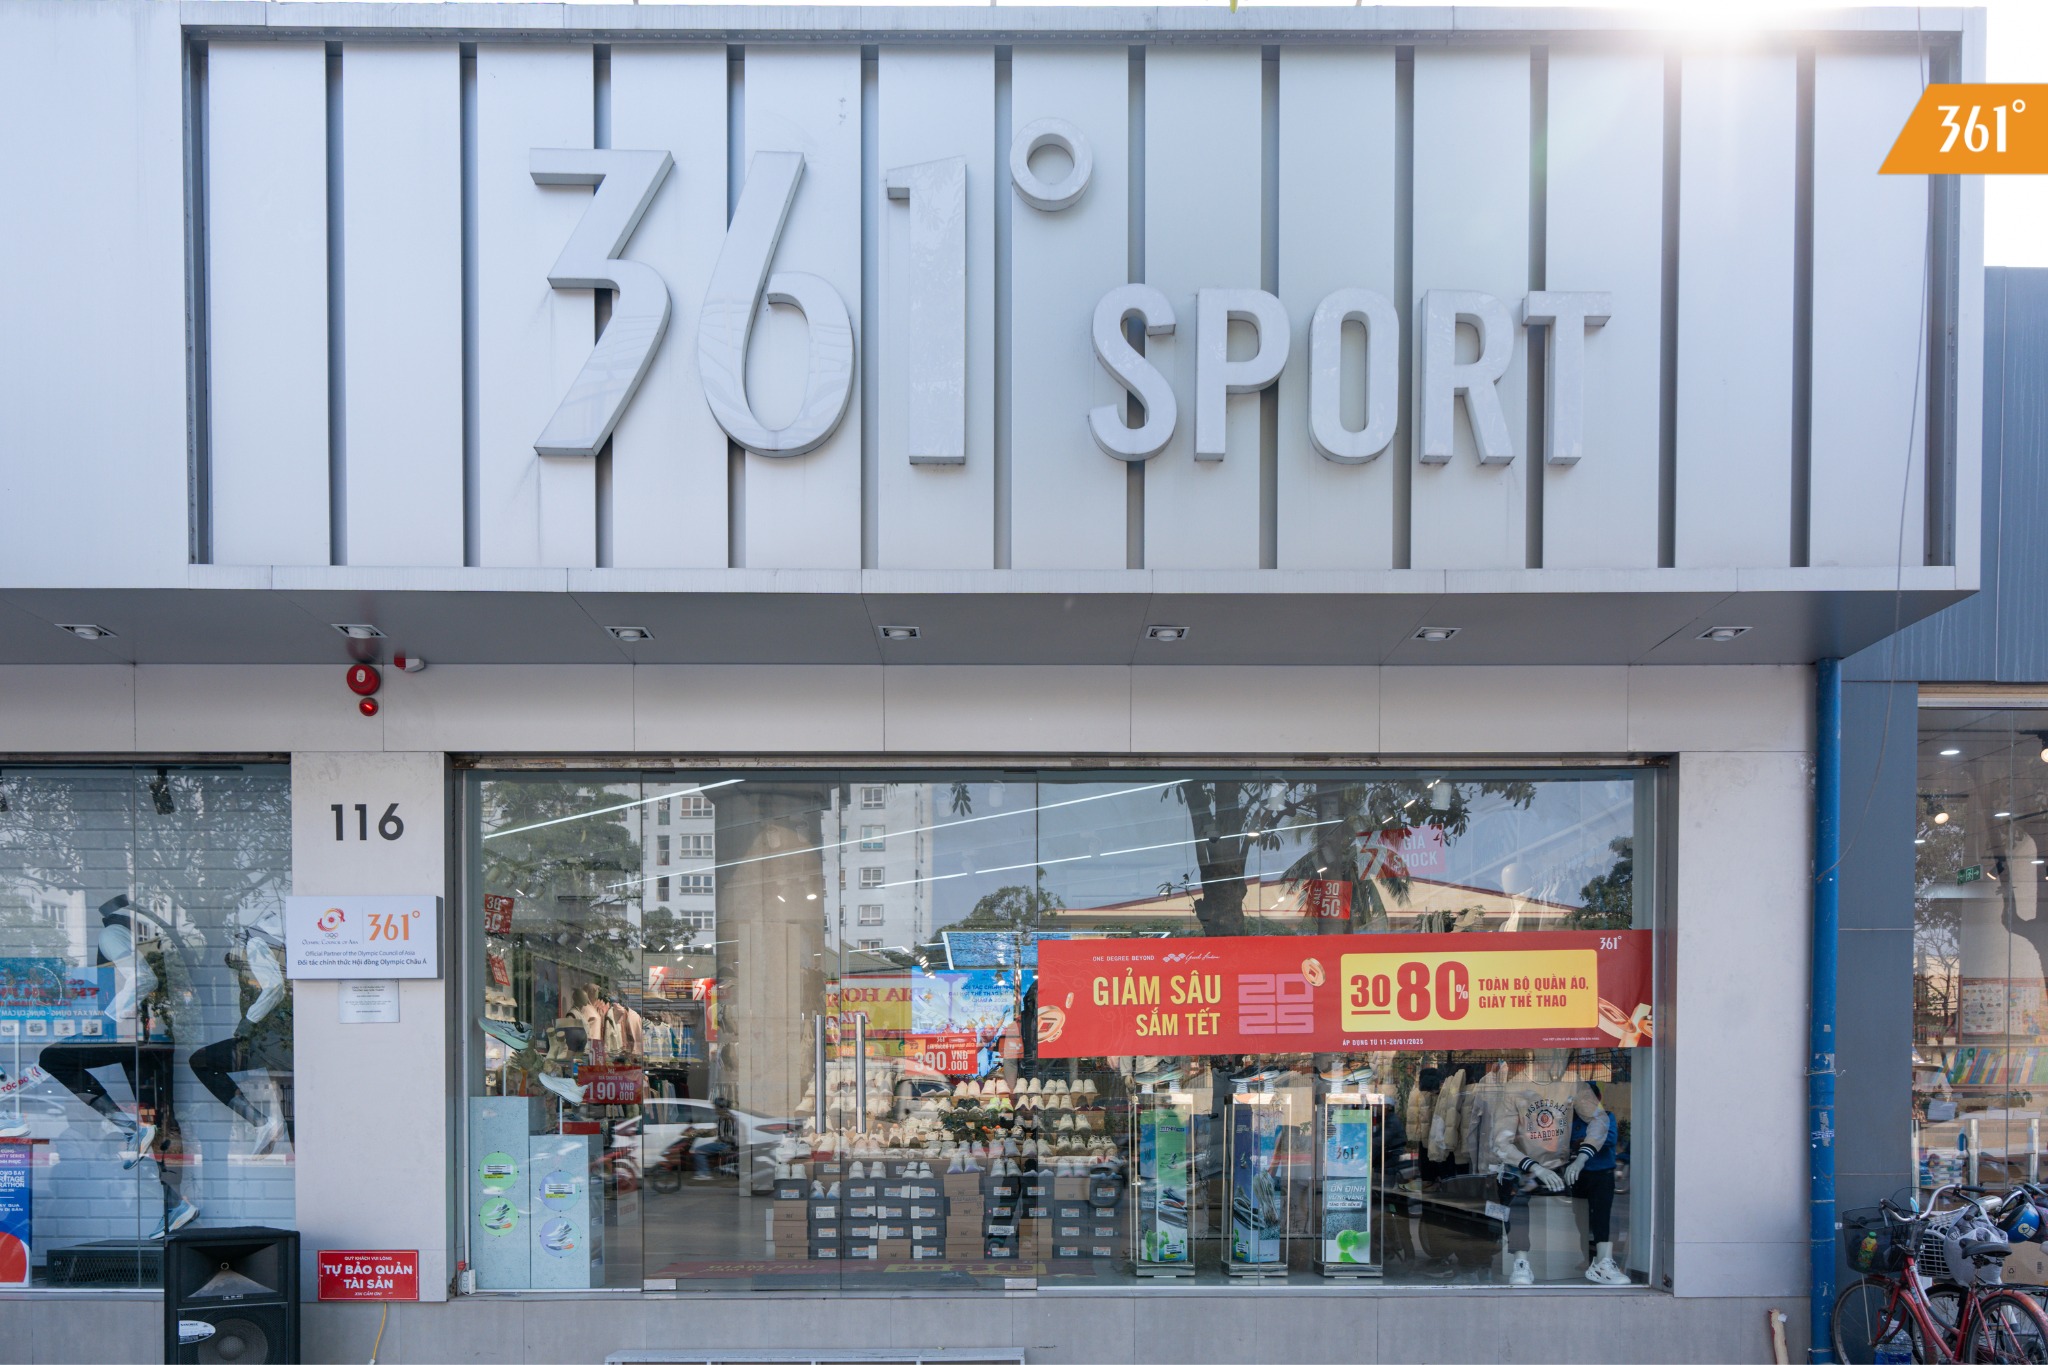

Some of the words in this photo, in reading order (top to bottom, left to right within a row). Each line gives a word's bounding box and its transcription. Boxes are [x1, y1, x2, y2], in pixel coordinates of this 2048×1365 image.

[529, 117, 1093, 464] 361°
[1088, 282, 1612, 465] SPORT
[330, 803, 404, 841] 116
[1393, 850, 1438, 869] SHOCK
[1312, 887, 1322, 906] SALE
[1093, 967, 1161, 1006] GIẢM
[1170, 969, 1222, 1005] SÂU
[1478, 976, 1509, 991] TOÀN
[1513, 975, 1530, 992] BỘ
[1534, 973, 1566, 991] QUẦN
[1570, 975, 1589, 990] ÁO,
[1478, 994, 1506, 1008] GIÀY
[1510, 991, 1532, 1008] THỂ
[1536, 994, 1567, 1007] THAO
[1135, 1006, 1179, 1037] SẮM
[1184, 1007, 1221, 1036] TẾT
[914, 1051, 947, 1072] 390
[588, 1081, 616, 1100] 190
[1525, 1098, 1568, 1119] BASKETBALL
[323, 1263, 343, 1277] TỰ
[345, 1261, 373, 1275] BẢO
[375, 1261, 413, 1275] QUẢN
[343, 1276, 364, 1289] TÀI
[366, 1275, 393, 1289] SẢN
